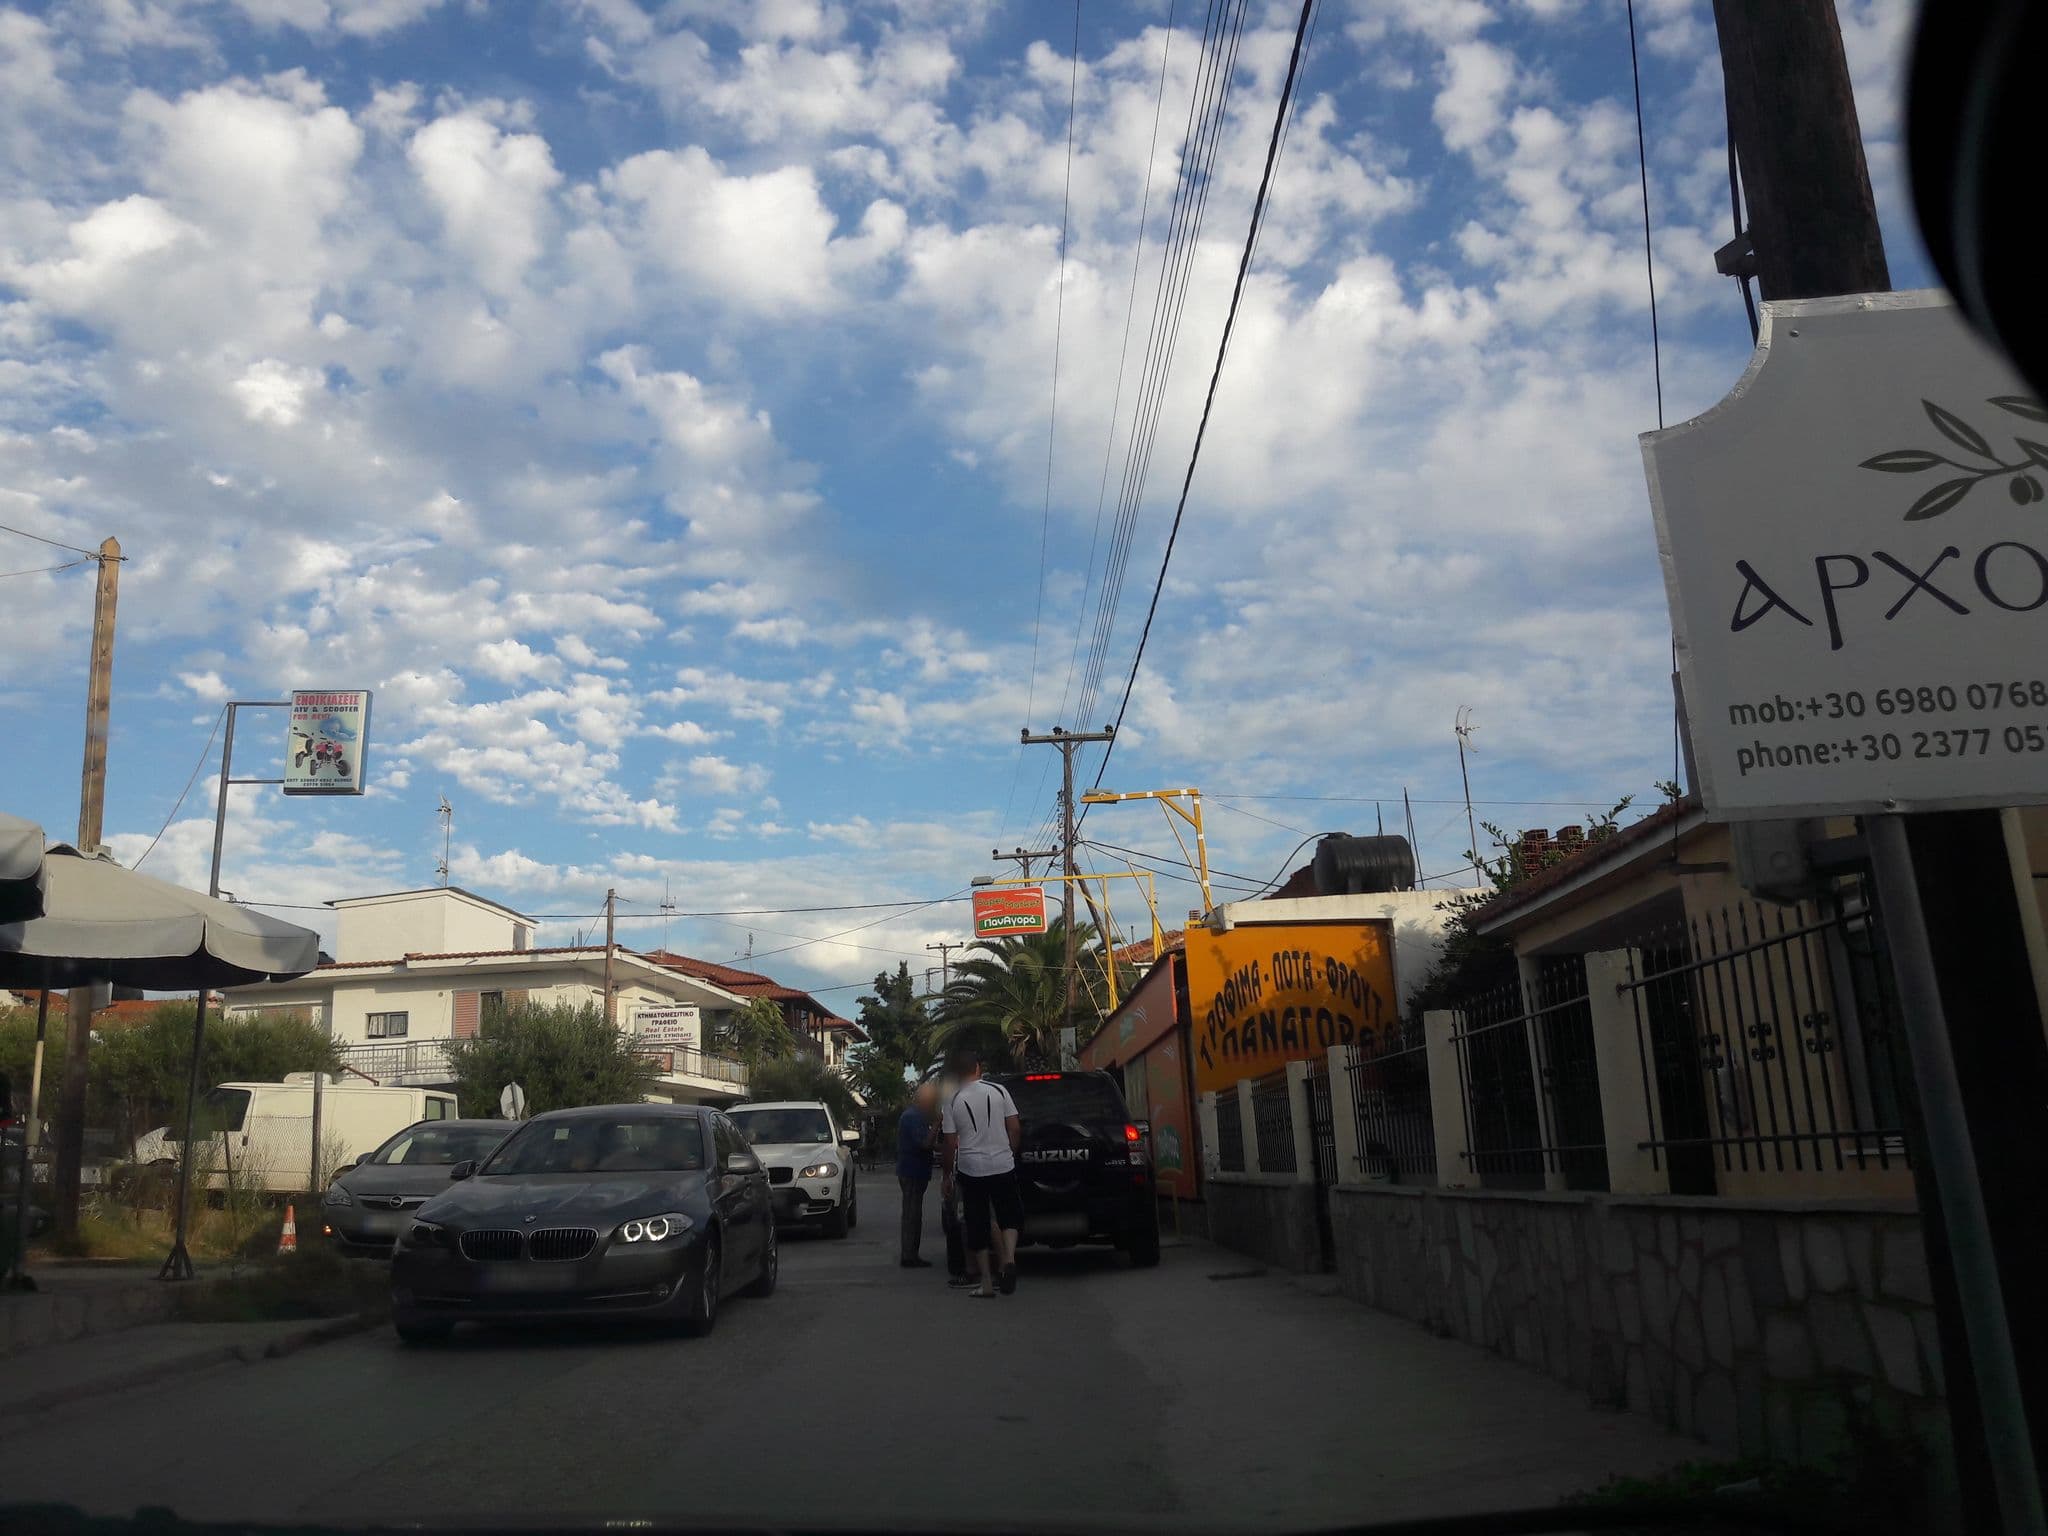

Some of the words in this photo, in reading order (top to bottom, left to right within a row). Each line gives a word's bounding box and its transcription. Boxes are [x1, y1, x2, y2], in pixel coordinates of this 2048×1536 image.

[1729, 692, 1865, 726] mob:+30
[1875, 686, 1955, 716] 6980
[1967, 680, 2048, 710] 0768
[1737, 733, 1902, 777] phone:+30
[1913, 728, 1991, 760] 2377
[2004, 725, 2048, 754] 05
[1272, 951, 1314, 992] ΠΟΤΑ
[1021, 1148, 1090, 1162] SUZUKI
